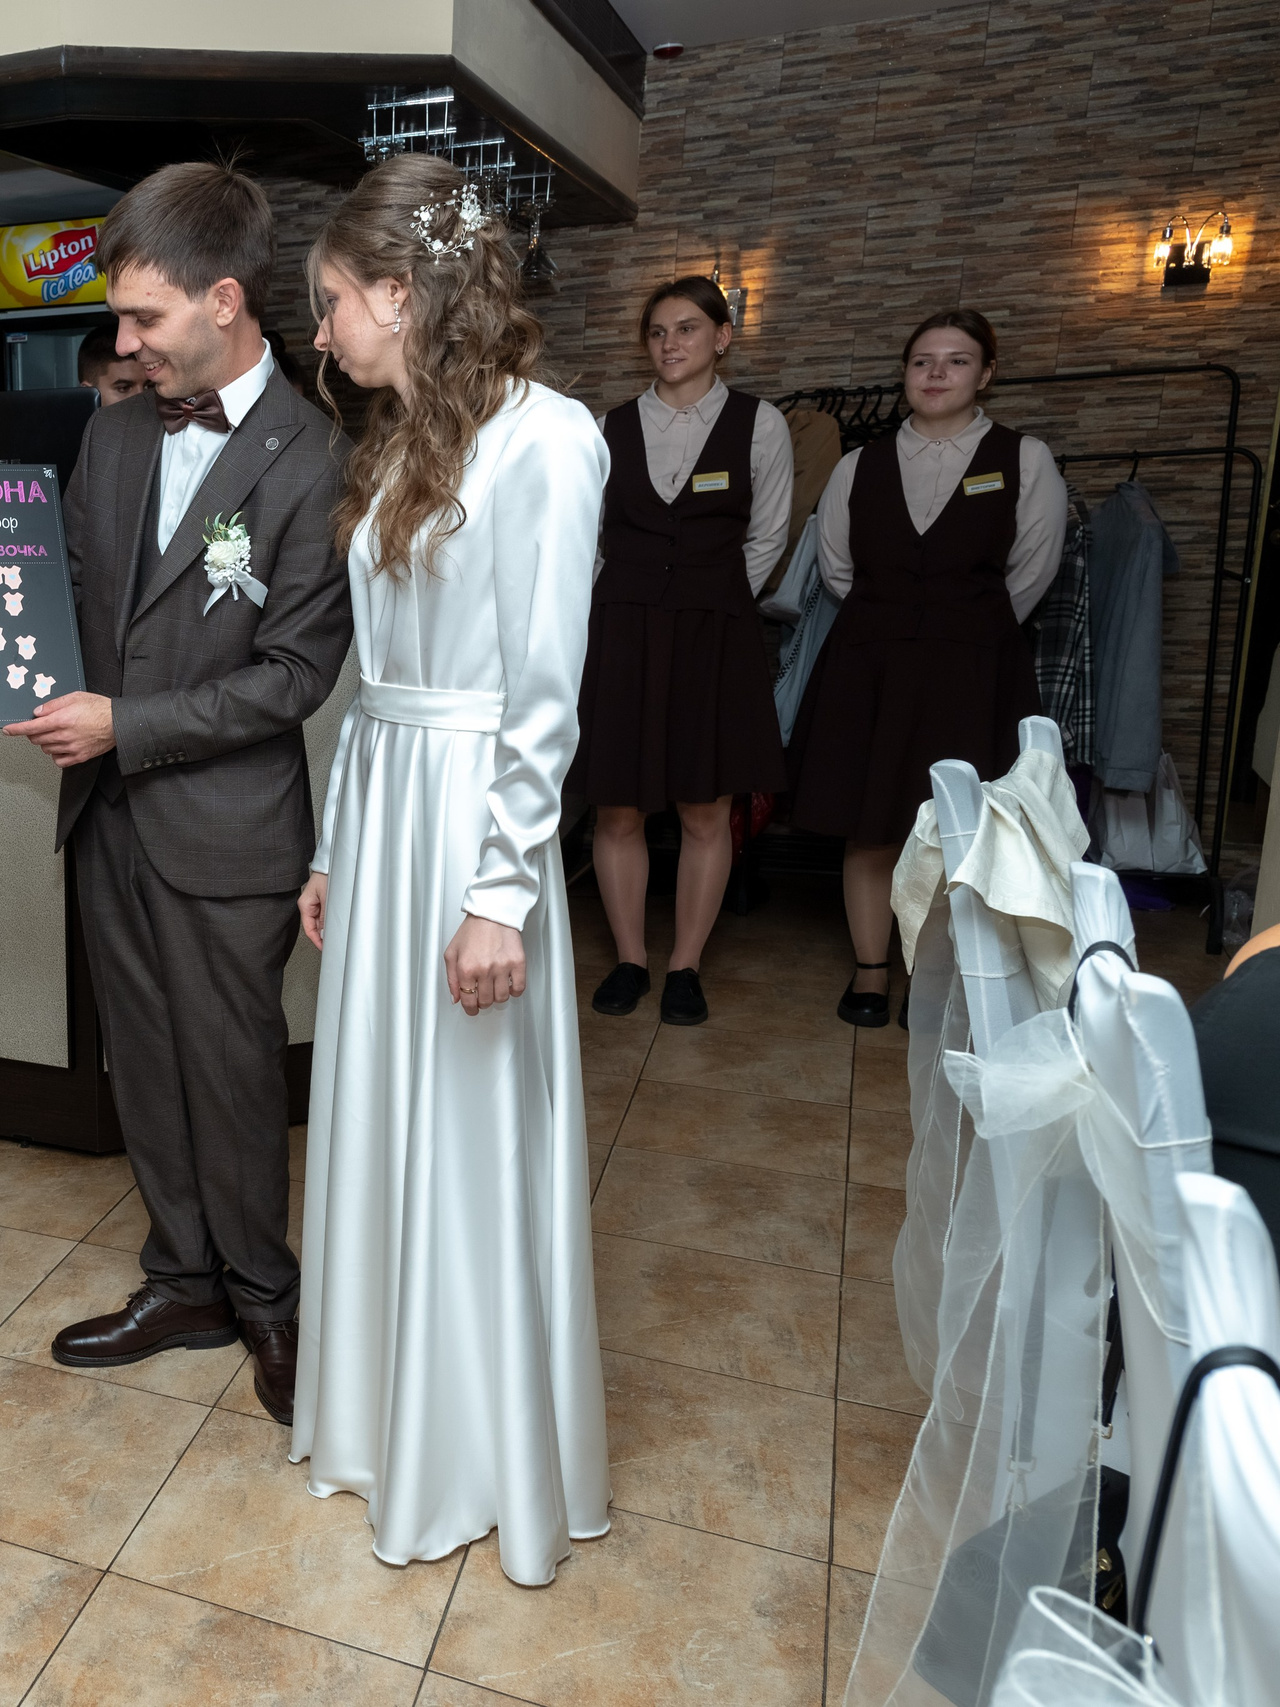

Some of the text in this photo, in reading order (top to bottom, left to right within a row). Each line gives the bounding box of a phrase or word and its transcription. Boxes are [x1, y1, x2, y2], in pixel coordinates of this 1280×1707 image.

[27, 234, 94, 272] Lipton
[42, 262, 96, 302] Ice Tea
